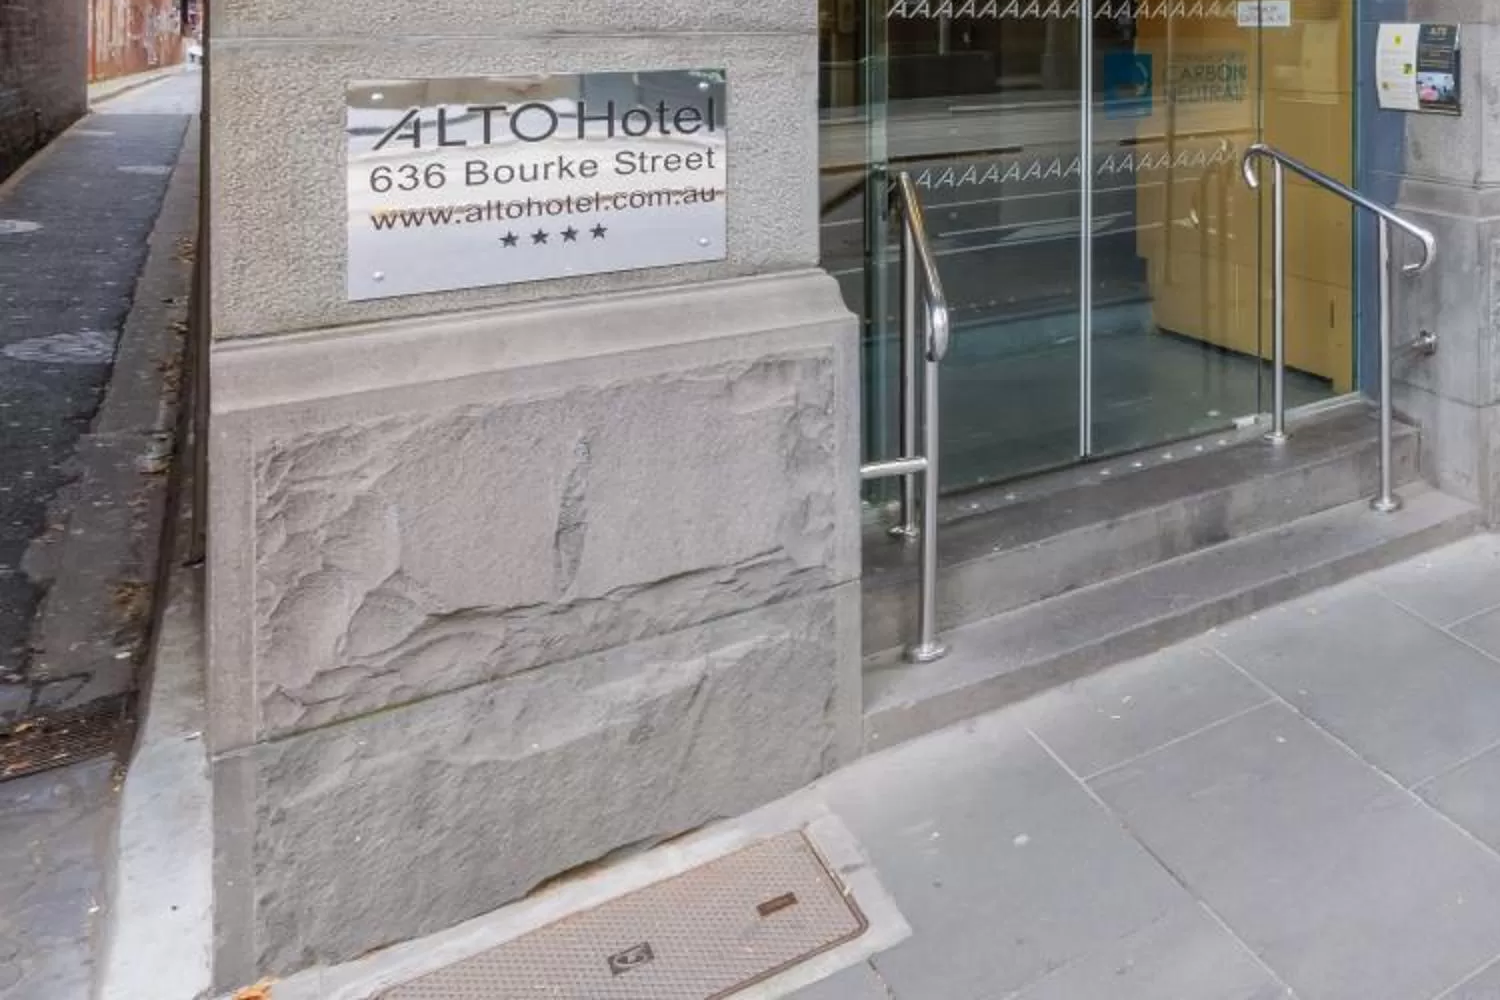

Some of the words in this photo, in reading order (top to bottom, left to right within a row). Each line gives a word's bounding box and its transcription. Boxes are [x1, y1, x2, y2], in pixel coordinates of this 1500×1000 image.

[372, 102, 559, 151] ALTO
[577, 96, 717, 140] Hotel
[369, 162, 447, 194] 636
[465, 156, 600, 187] Bourke
[614, 146, 717, 175] Street
[370, 186, 717, 231] www.altohotel.com.au
